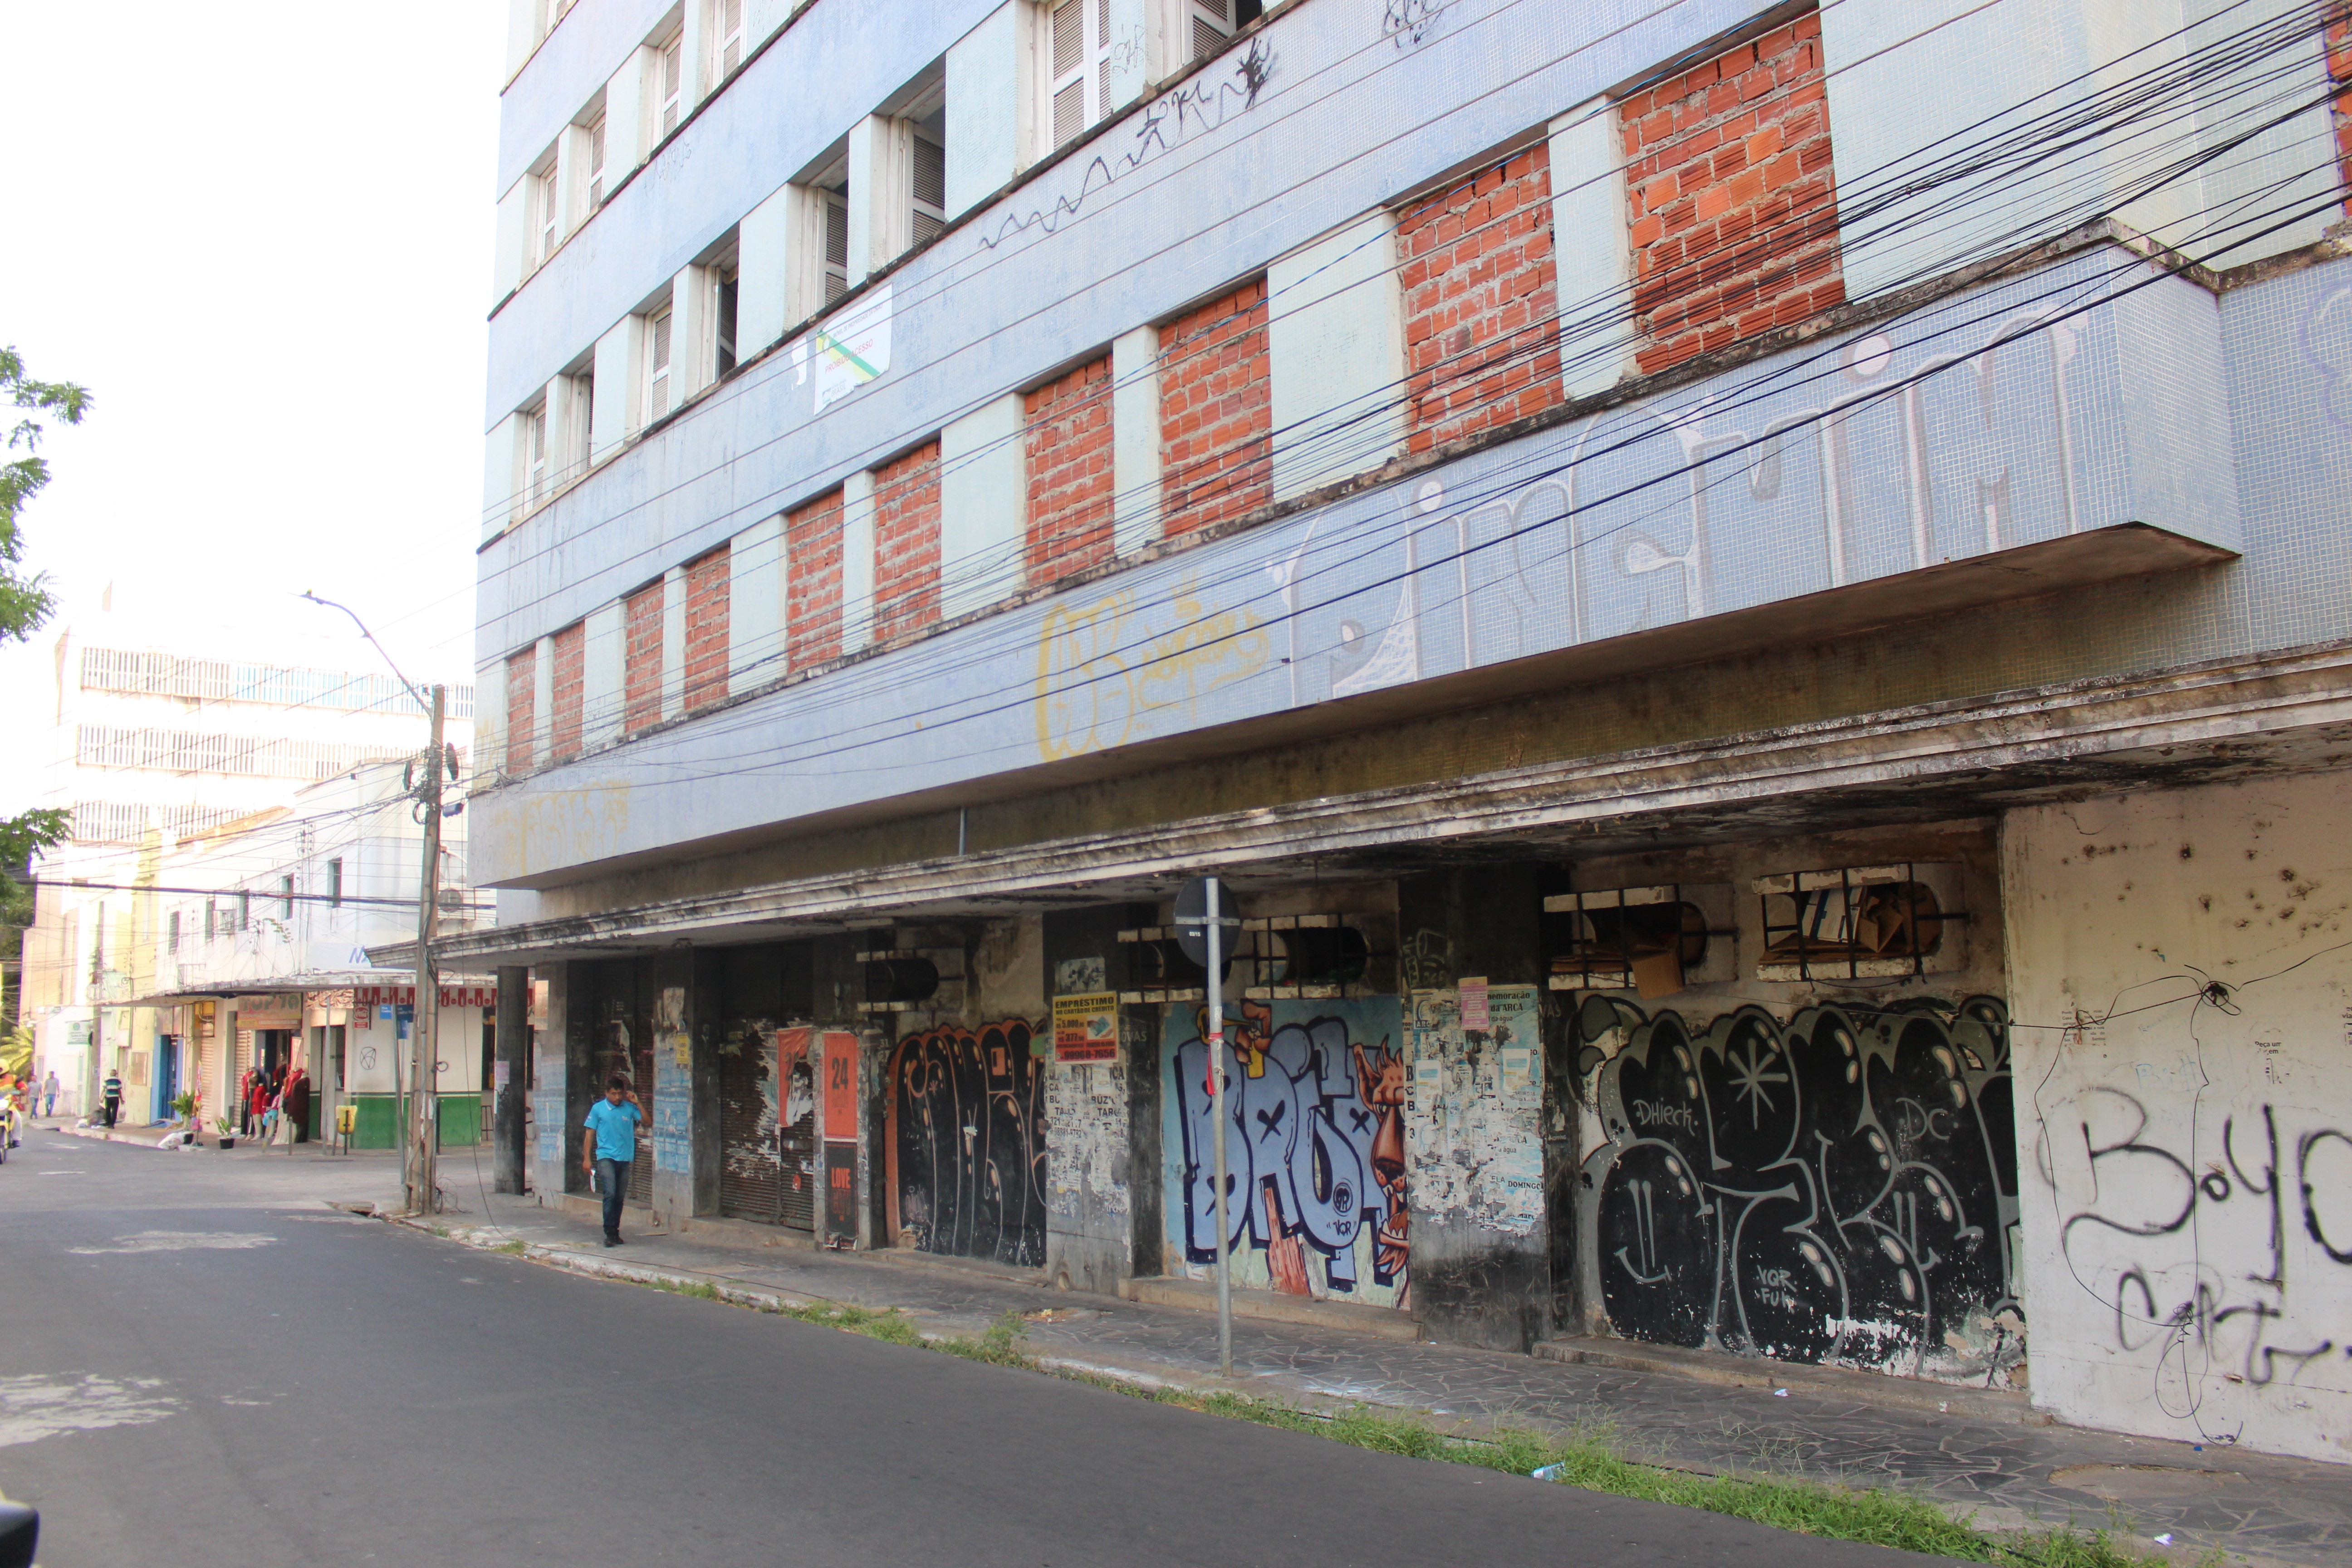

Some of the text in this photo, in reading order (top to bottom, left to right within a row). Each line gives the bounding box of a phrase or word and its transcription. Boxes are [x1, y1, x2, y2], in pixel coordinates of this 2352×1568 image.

[848, 313, 868, 330] PROPRIEDADE
[825, 338, 873, 374] PROIBIDO ACESSO
[831, 383, 846, 397] BRASIL
[241, 994, 274, 1012] TOP
[1055, 997, 1114, 1009] EMPRÉSTIMO
[1491, 1003, 1523, 1012] da ARCA
[832, 1057, 848, 1090] 24
[1503, 1146, 1517, 1154] água
[831, 1167, 852, 1189] LOVE
